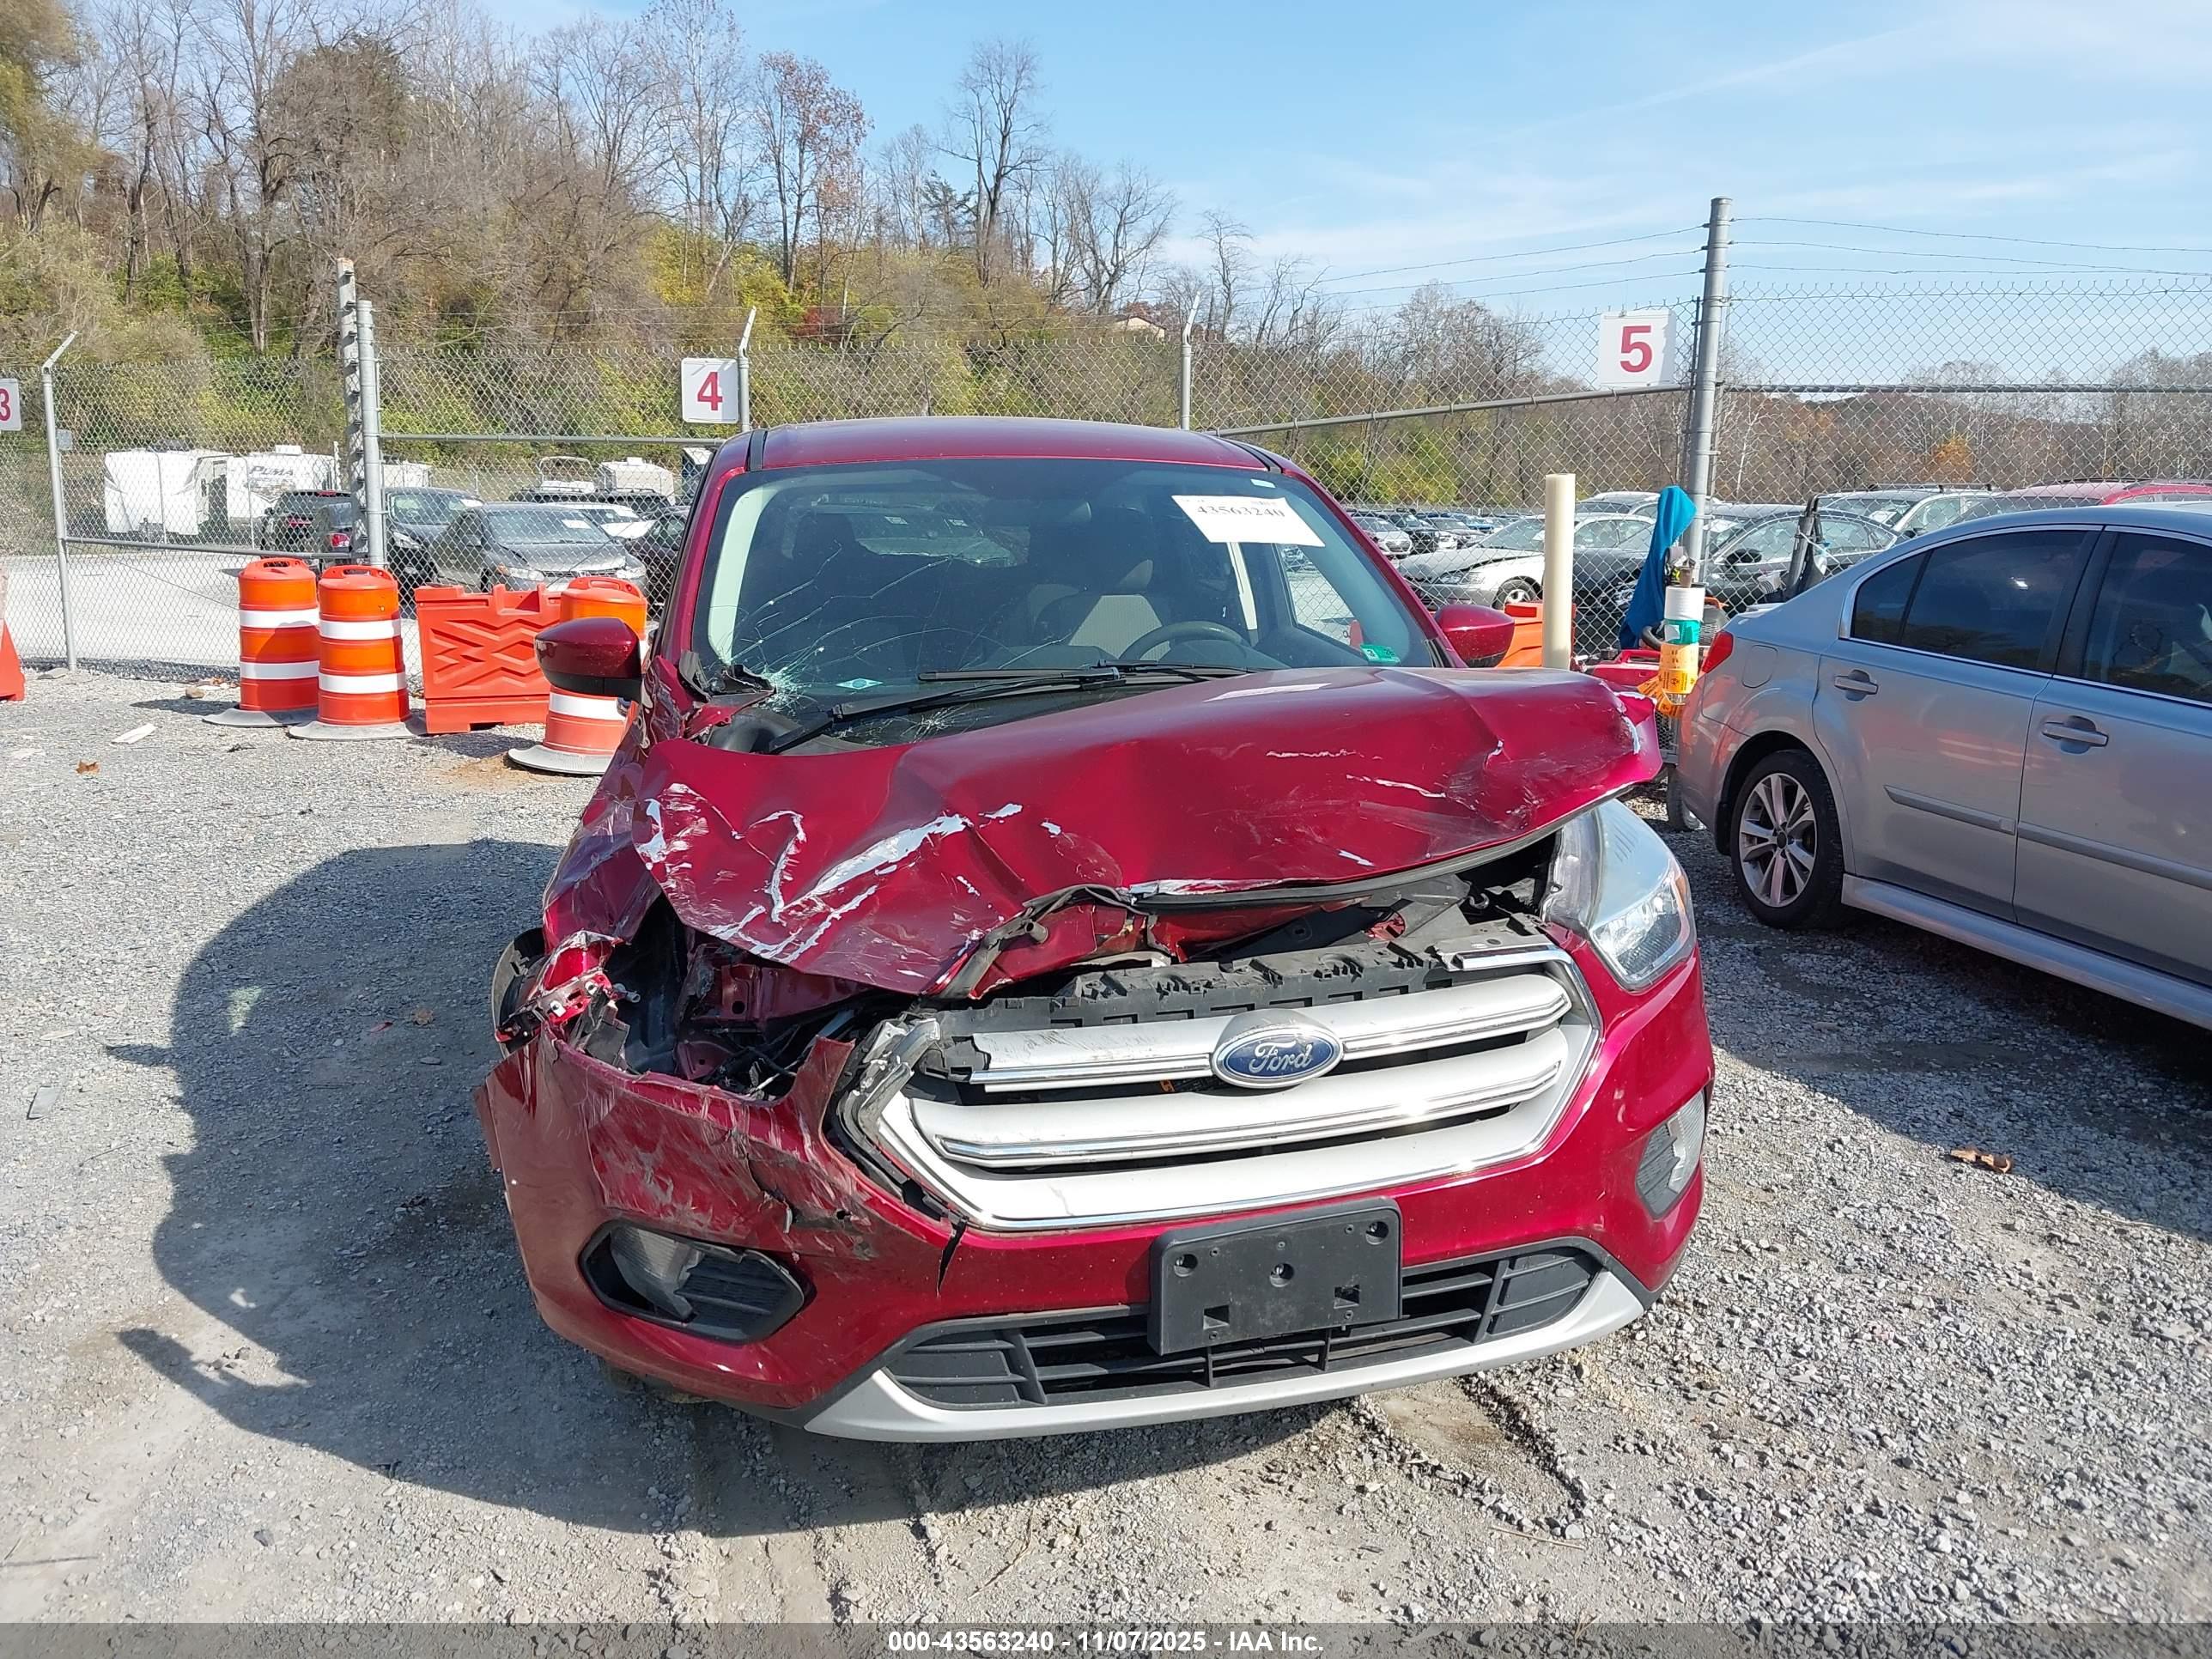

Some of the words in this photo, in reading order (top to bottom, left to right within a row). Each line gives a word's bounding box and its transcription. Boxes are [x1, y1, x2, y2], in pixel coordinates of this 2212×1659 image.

[1620, 325, 1653, 373] 5
[0, 388, 11, 421] 3
[697, 371, 723, 410] 4
[249, 465, 294, 476] PUMA
[1197, 506, 1285, 517] 43563240
[1249, 1040, 1314, 1073] Ford
